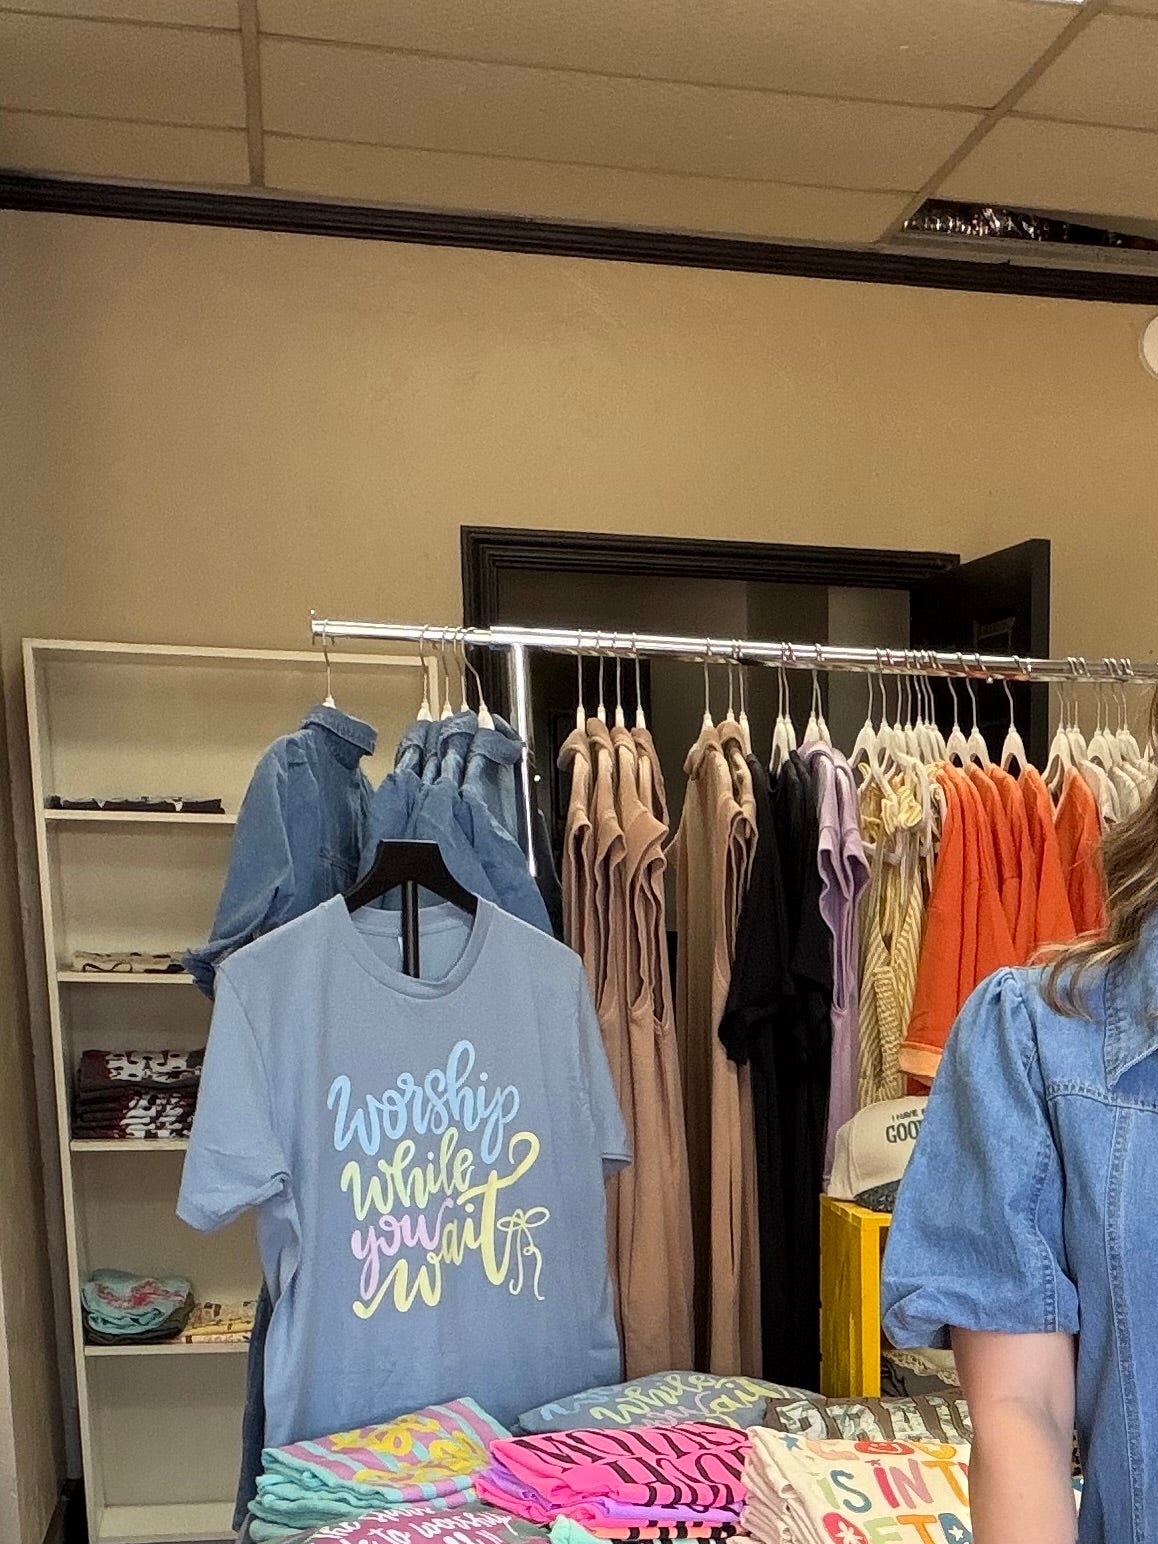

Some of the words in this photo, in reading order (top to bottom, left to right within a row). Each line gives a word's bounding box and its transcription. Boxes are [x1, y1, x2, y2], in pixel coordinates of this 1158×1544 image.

[326, 1039, 520, 1165] Worship
[885, 1118, 923, 1144] GOO
[351, 1197, 454, 1300] you
[352, 1131, 541, 1319] wait
[815, 1468, 873, 1514] IS
[864, 1458, 935, 1511] IN
